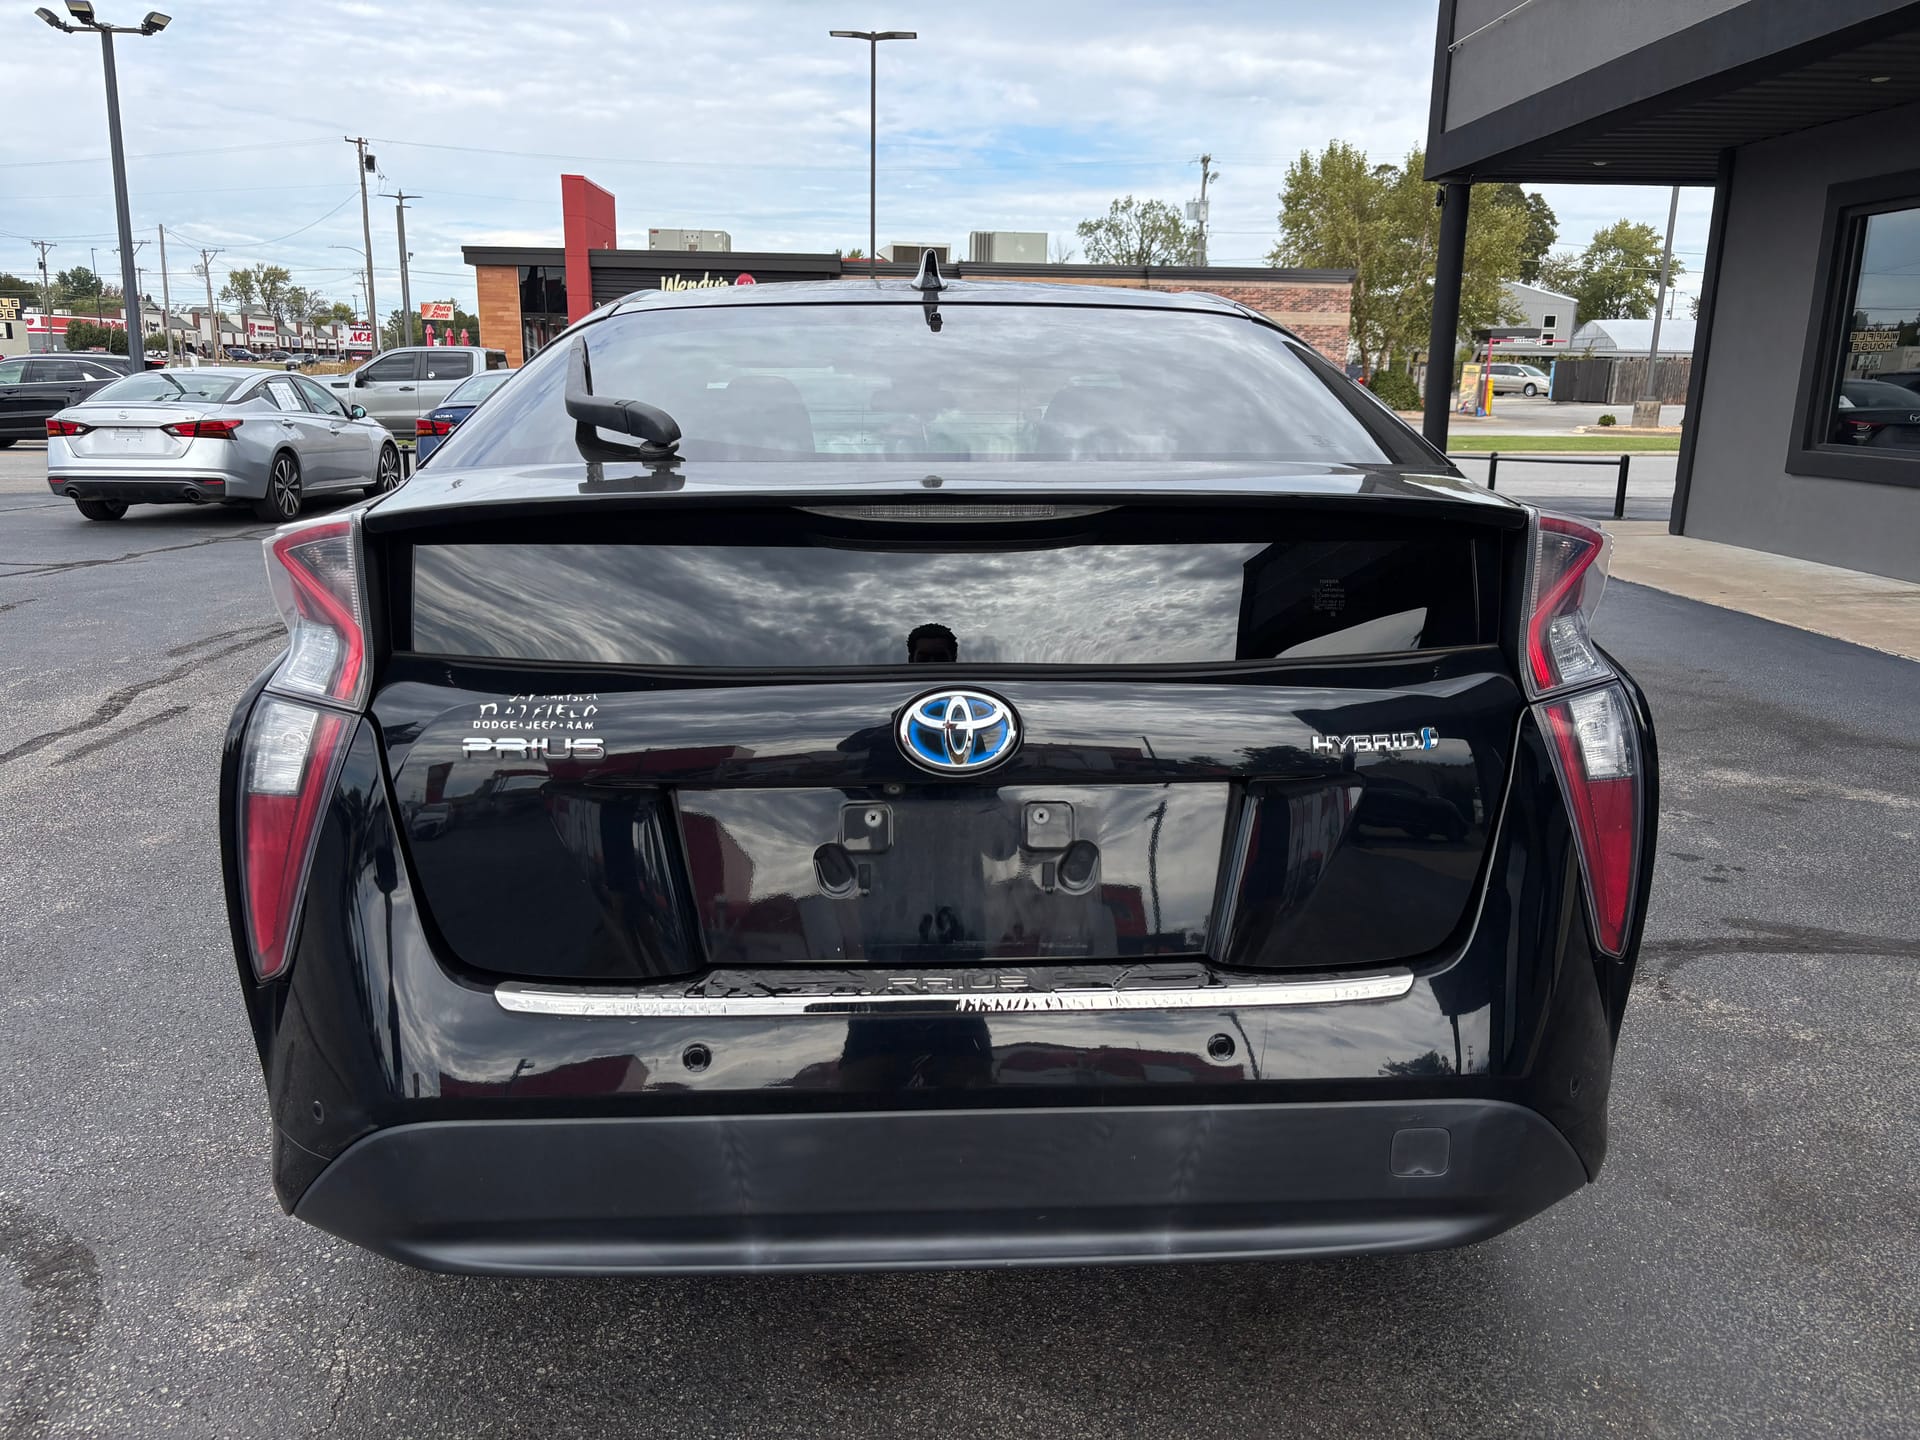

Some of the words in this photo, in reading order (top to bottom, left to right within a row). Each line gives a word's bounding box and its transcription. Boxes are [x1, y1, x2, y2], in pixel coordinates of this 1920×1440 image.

[661, 271, 729, 292] Wendy's
[434, 304, 452, 312] Auto
[472, 720, 518, 730] DODGE
[525, 720, 557, 730] JEEP
[566, 720, 594, 730] RAM
[462, 737, 605, 759] PRIUS
[1312, 732, 1420, 753] HYBRID
